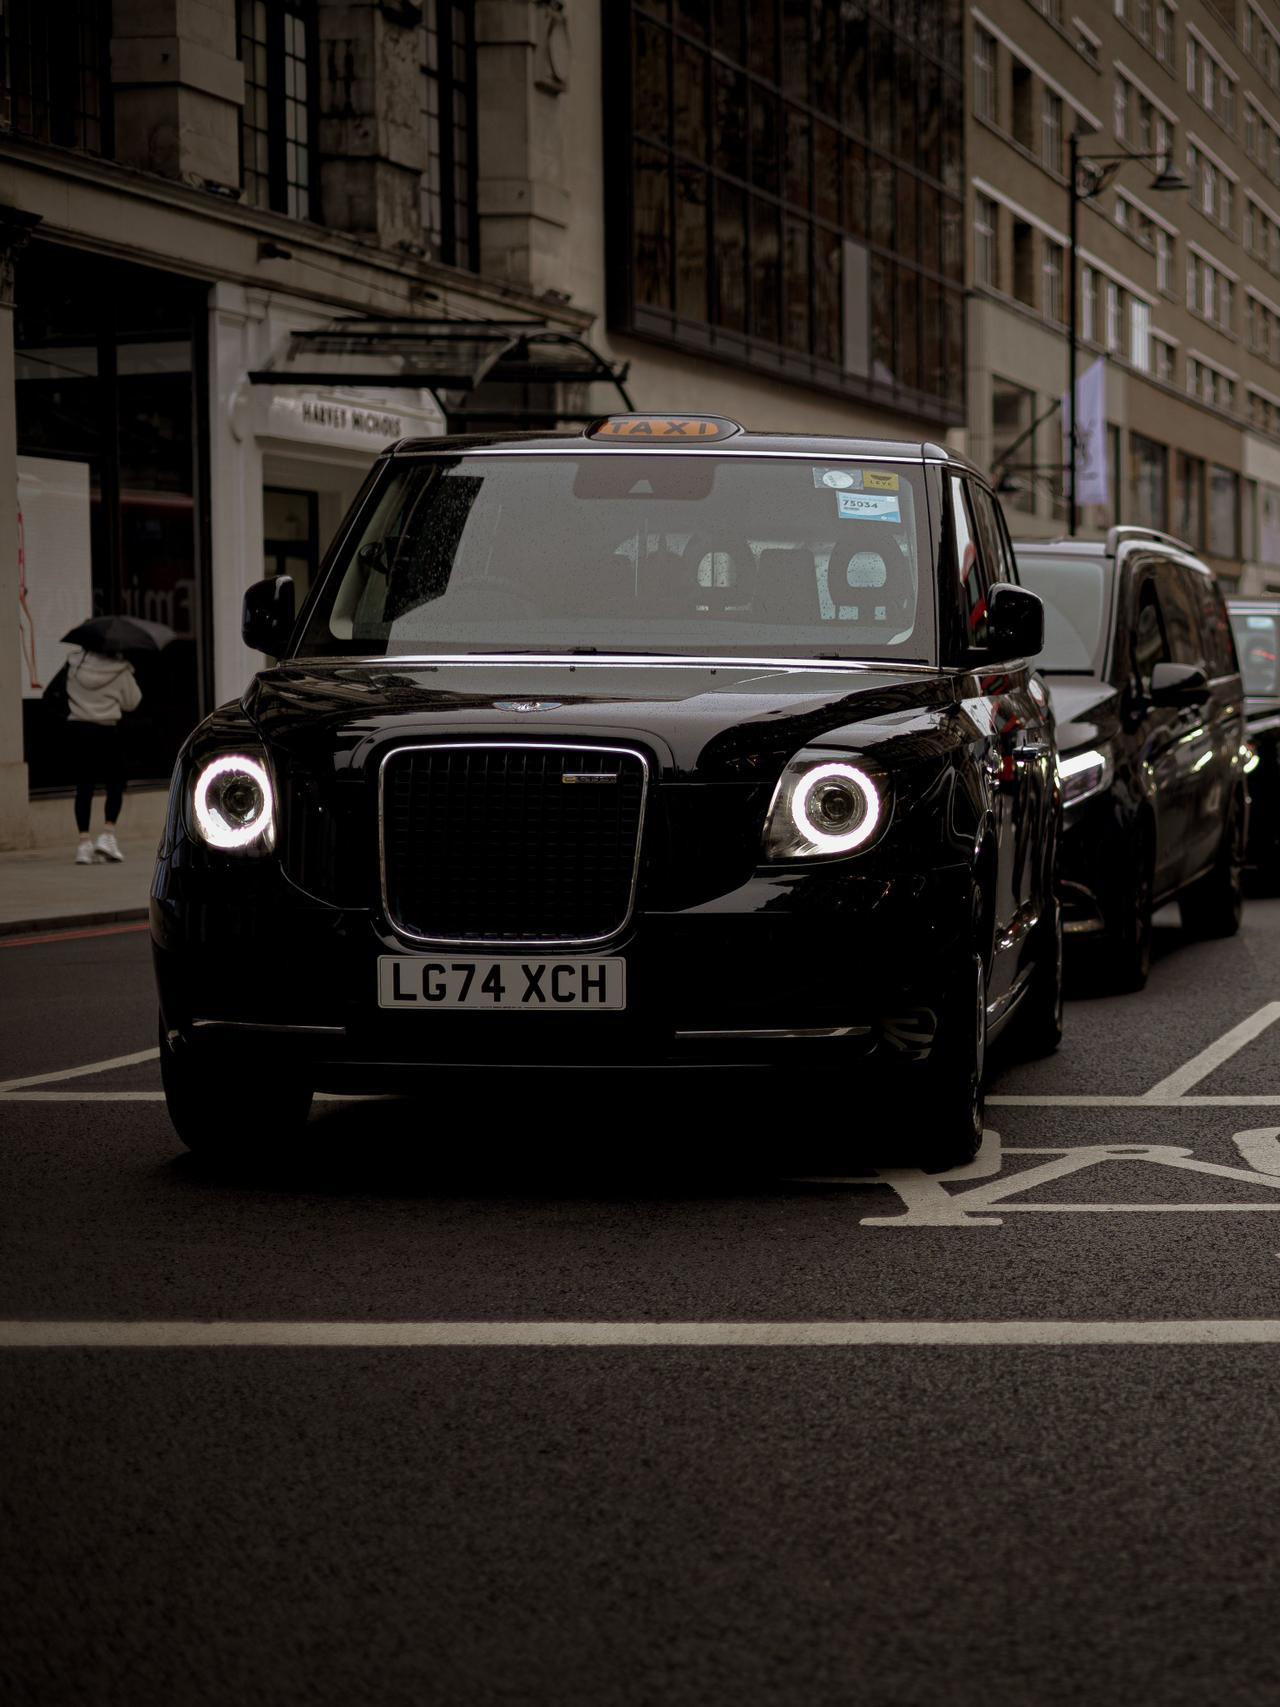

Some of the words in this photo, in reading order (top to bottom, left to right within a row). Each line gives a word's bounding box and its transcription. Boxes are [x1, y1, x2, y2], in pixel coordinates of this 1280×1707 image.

[610, 421, 707, 435] TAXI
[843, 499, 878, 509] 75034
[393, 963, 506, 1002] LG74
[521, 964, 606, 1003] XCH
